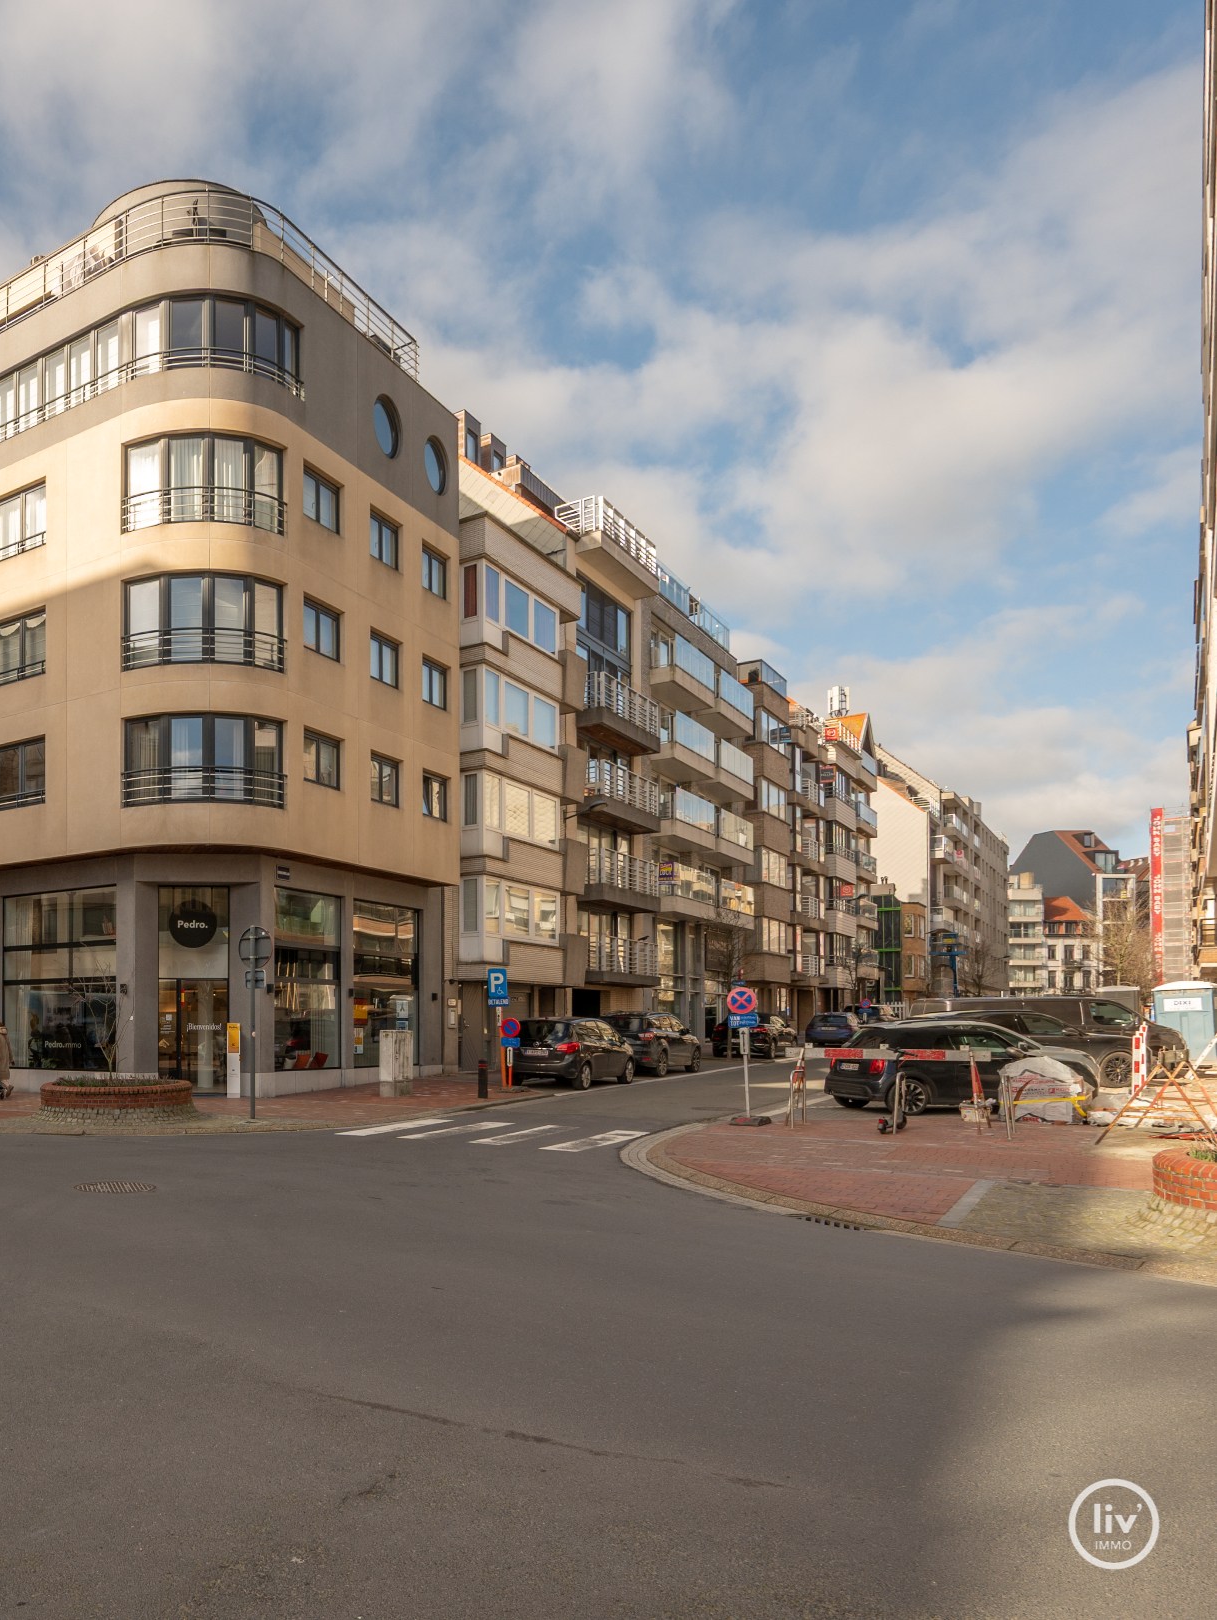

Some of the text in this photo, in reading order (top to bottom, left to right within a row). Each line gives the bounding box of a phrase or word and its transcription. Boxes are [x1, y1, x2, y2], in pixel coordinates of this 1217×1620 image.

[177, 919, 208, 929] Pedro.
[490, 972, 504, 993] P
[488, 998, 509, 1006] BETALEND
